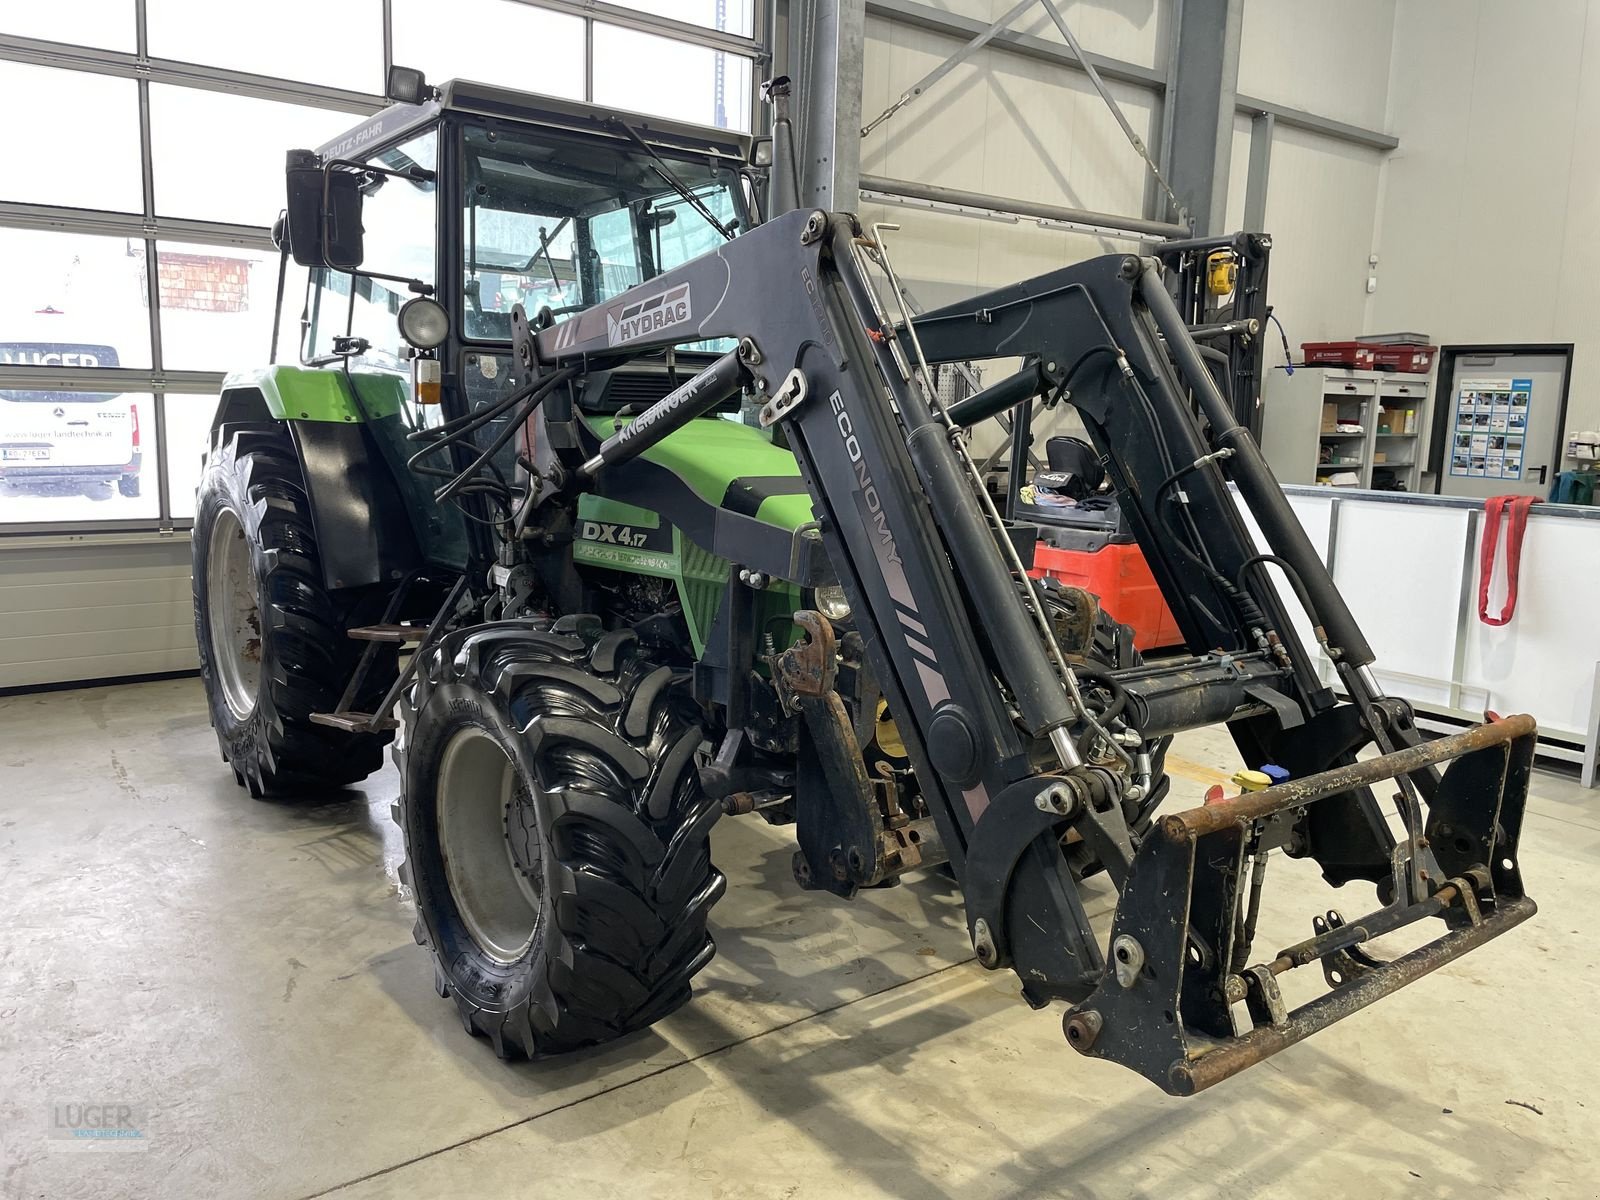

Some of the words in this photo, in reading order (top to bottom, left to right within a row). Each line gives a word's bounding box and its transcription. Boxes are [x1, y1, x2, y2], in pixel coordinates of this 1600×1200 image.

[620, 301, 687, 341] HYDRAC
[829, 389, 903, 566] ECONOMY
[582, 521, 618, 544] DX
